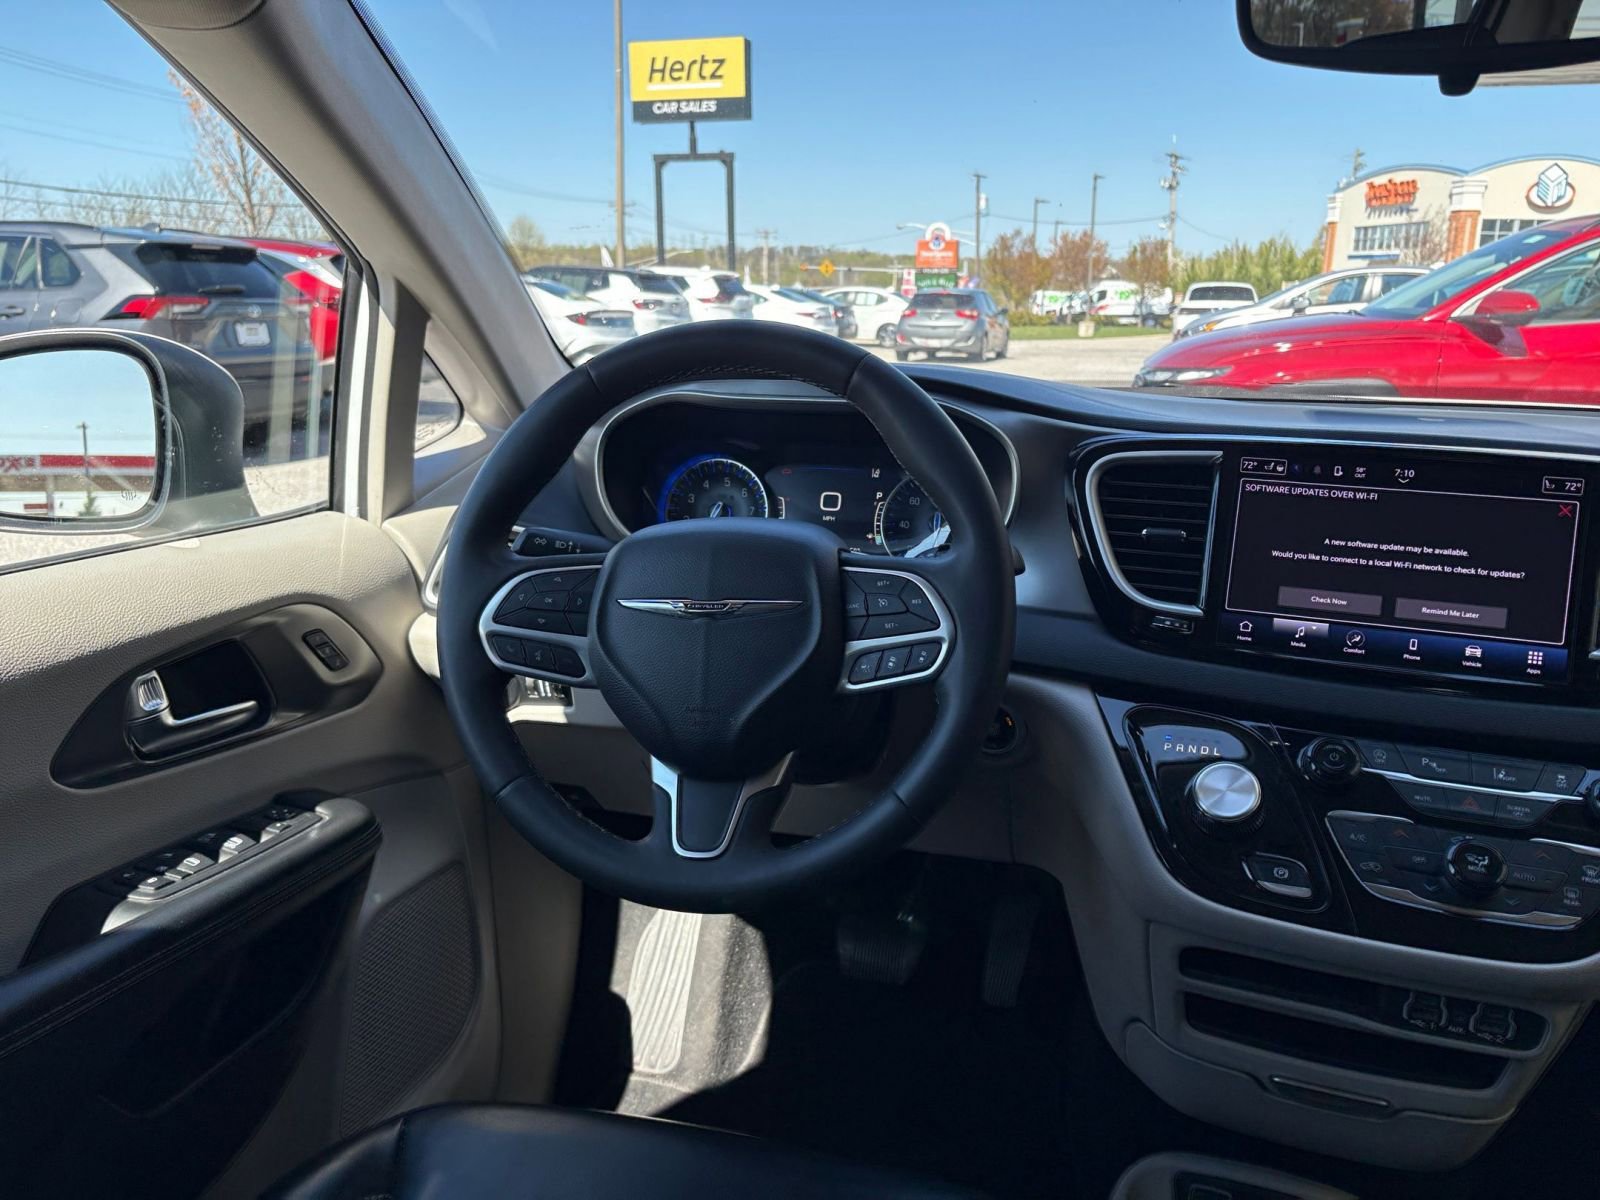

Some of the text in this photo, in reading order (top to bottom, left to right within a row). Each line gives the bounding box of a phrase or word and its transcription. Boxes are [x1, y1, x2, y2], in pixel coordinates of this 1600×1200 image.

[648, 54, 726, 82] Hertz
[652, 100, 717, 114] CAR SALES
[1395, 468, 1415, 478] 7:10
[703, 479, 710, 489] 4
[724, 477, 731, 487] 5
[1565, 481, 1582, 491] 72°
[741, 488, 748, 498] 6
[876, 491, 883, 500] P
[1245, 483, 1378, 501] SOFTWARE UPDATES OVER WI-FI
[688, 493, 695, 503] 3
[909, 496, 920, 506] 60
[899, 520, 910, 529] 40
[1331, 539, 1346, 547] new
[1347, 541, 1379, 550] software
[1379, 543, 1405, 552] update
[1406, 546, 1422, 555] may
[1271, 549, 1293, 559] Would
[1294, 552, 1307, 560] you
[1308, 553, 1321, 561] like
[1330, 556, 1358, 565] connect
[1374, 559, 1392, 567] local
[1393, 561, 1412, 569] Wi-Fi
[1413, 563, 1443, 572] network
[1453, 566, 1476, 575] check
[1477, 568, 1488, 576] for
[1489, 569, 1526, 580] updates?
[1310, 596, 1347, 606] Check Now
[1421, 607, 1480, 619] Remind Me Later
[1236, 634, 1252, 642] Home
[1343, 647, 1365, 655] Comfort
[1403, 653, 1421, 661] Phone
[1462, 660, 1483, 668] Vehicle
[1526, 667, 1541, 675] Apps
